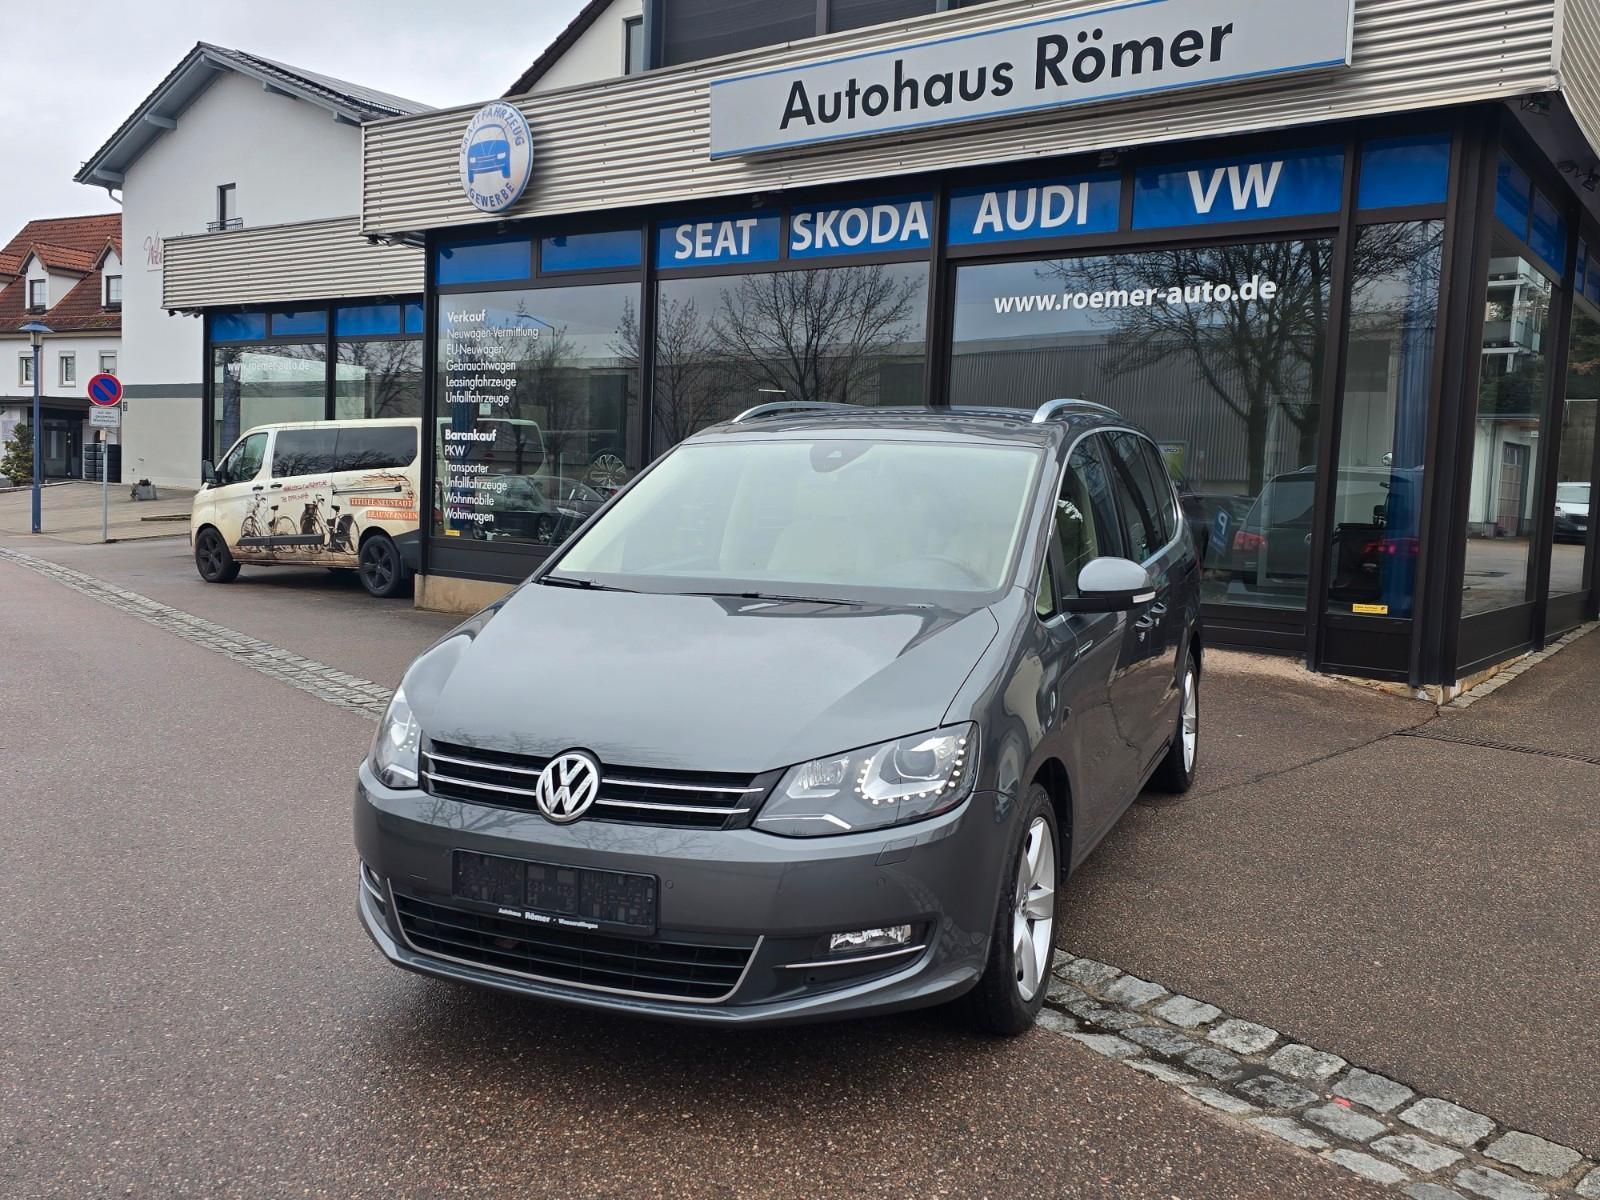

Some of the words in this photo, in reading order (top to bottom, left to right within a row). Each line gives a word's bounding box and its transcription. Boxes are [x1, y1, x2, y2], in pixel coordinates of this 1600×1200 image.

[779, 59, 1013, 130] Autohaus
[1034, 22, 1233, 90] Römer
[469, 182, 515, 208] GEWERBE
[1187, 161, 1285, 215] VW
[973, 182, 1089, 235] AUDI
[791, 201, 930, 252] SKODA
[674, 218, 758, 261] SEAT
[994, 274, 1278, 315] www.roemer-auto.de
[447, 309, 487, 323] Verkauf
[447, 326, 539, 341] Neuwagen-Vermittlung
[446, 344, 504, 357] EU-Neuwagen
[446, 360, 516, 373] Gebrauchtwagen
[445, 376, 517, 390] Leasingfahrzeuge
[445, 391, 510, 406] Unfallfahrzeuge
[444, 429, 497, 442] Barankauf
[444, 445, 465, 456] PKW
[444, 460, 489, 474] Transporter
[444, 475, 508, 491] Unfallfahrzeuge
[444, 491, 495, 506] Wohnmobile
[443, 507, 494, 522] Wohnwagen
[525, 912, 550, 923] Römer
